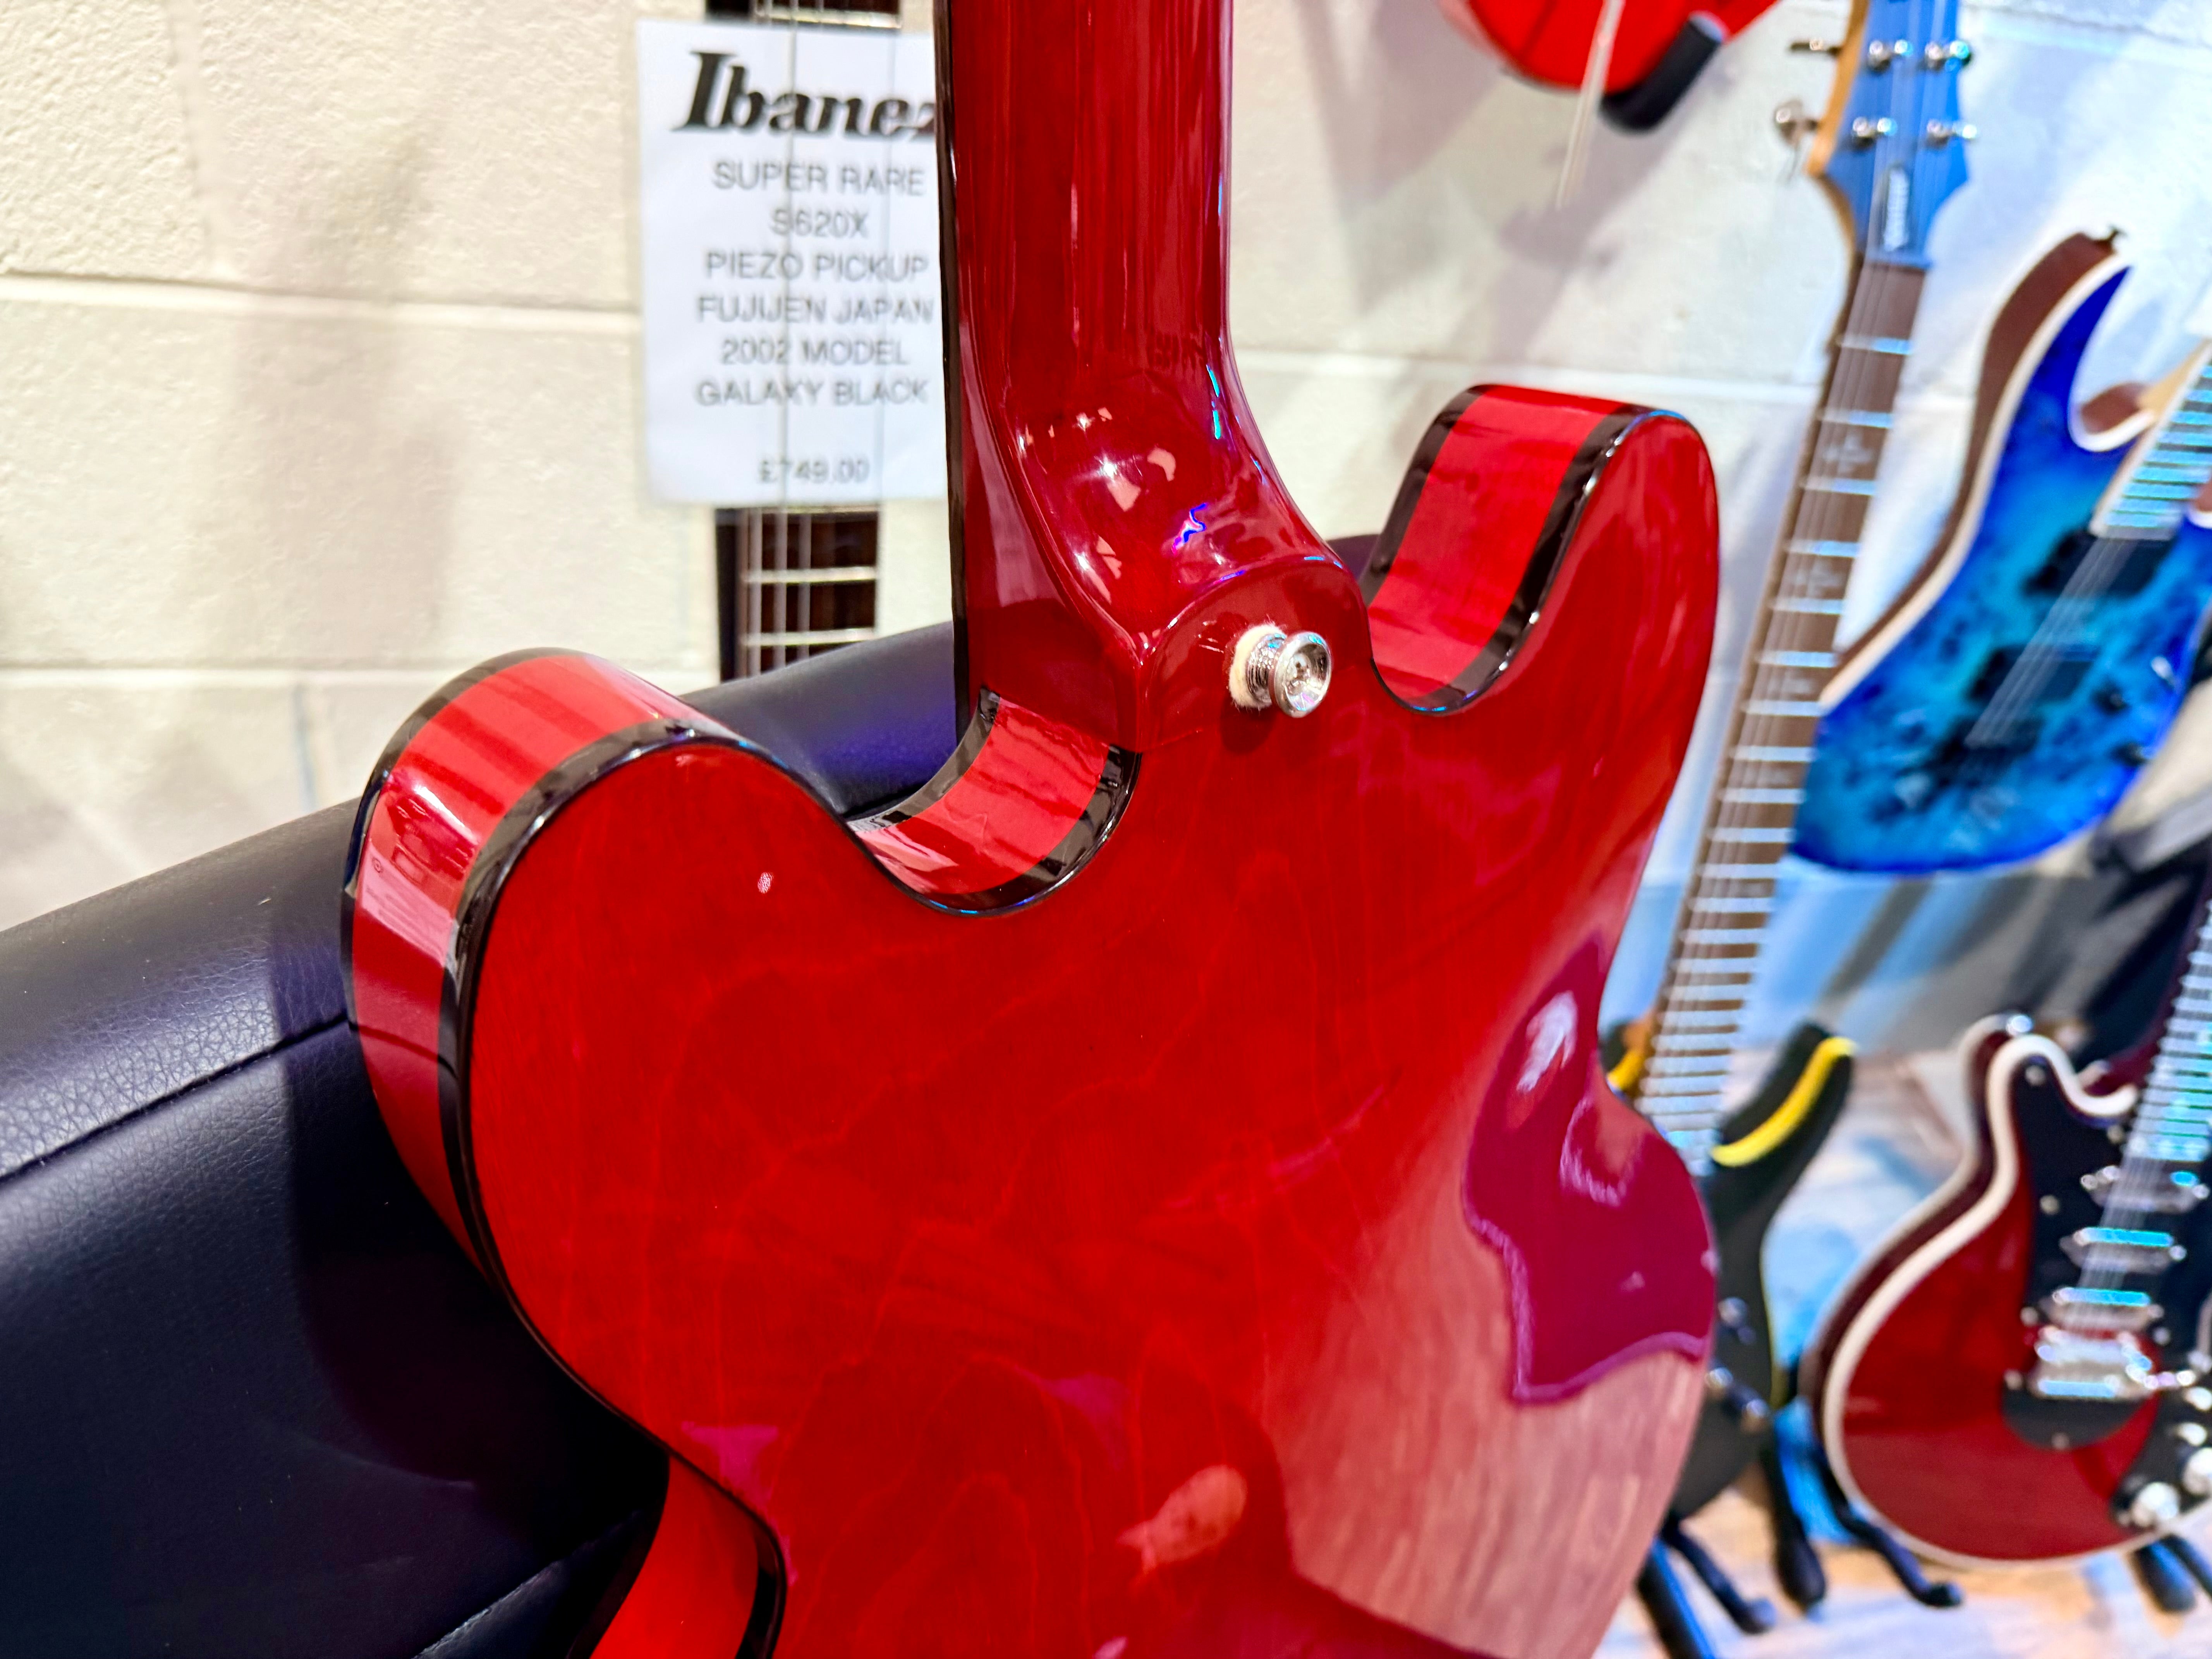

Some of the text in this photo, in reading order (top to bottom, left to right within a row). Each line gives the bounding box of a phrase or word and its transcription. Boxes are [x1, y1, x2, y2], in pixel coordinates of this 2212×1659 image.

[712, 160, 925, 196] SUPER RARE
[769, 208, 869, 238] S620X
[706, 252, 929, 282] PIEZO PICKUP
[833, 297, 934, 324] JAPAN
[721, 338, 909, 366] 2002 MODEL
[696, 380, 929, 406] GALAXY BLACK
